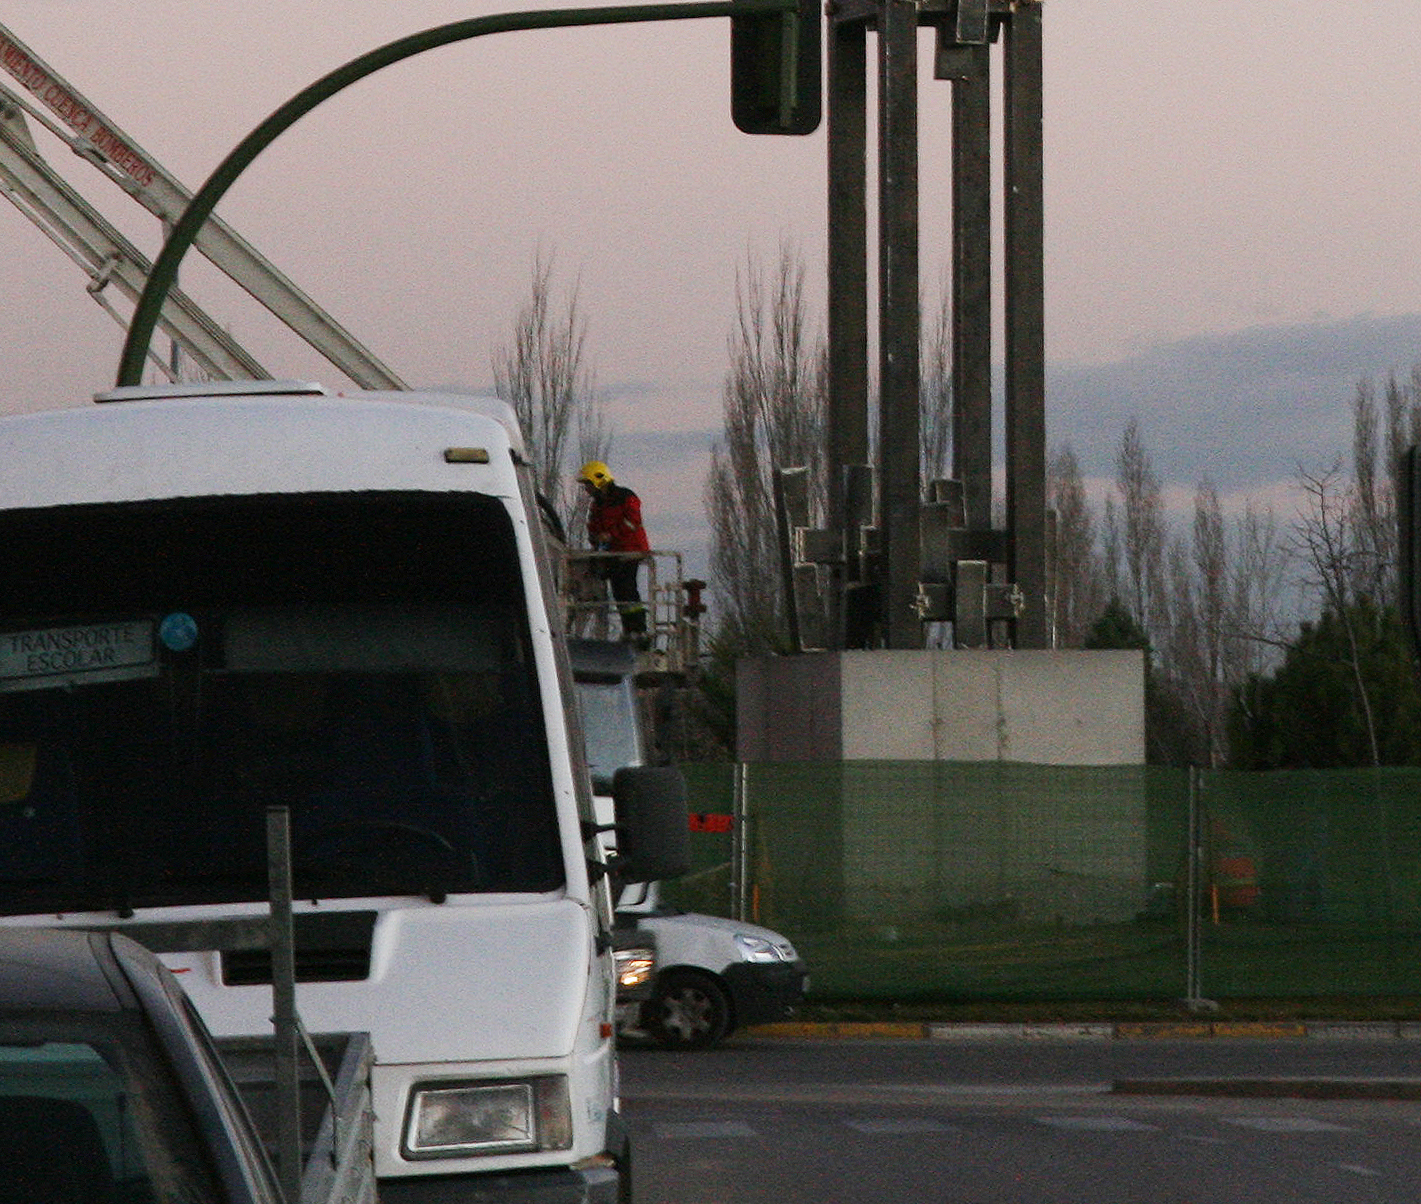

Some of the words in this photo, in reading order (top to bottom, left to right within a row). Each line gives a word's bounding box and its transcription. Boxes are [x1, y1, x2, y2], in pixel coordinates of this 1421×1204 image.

[89, 125, 156, 187] BOMBEROS
[12, 627, 135, 653] TRANSPORTE
[27, 647, 116, 672] ESCOLAR
